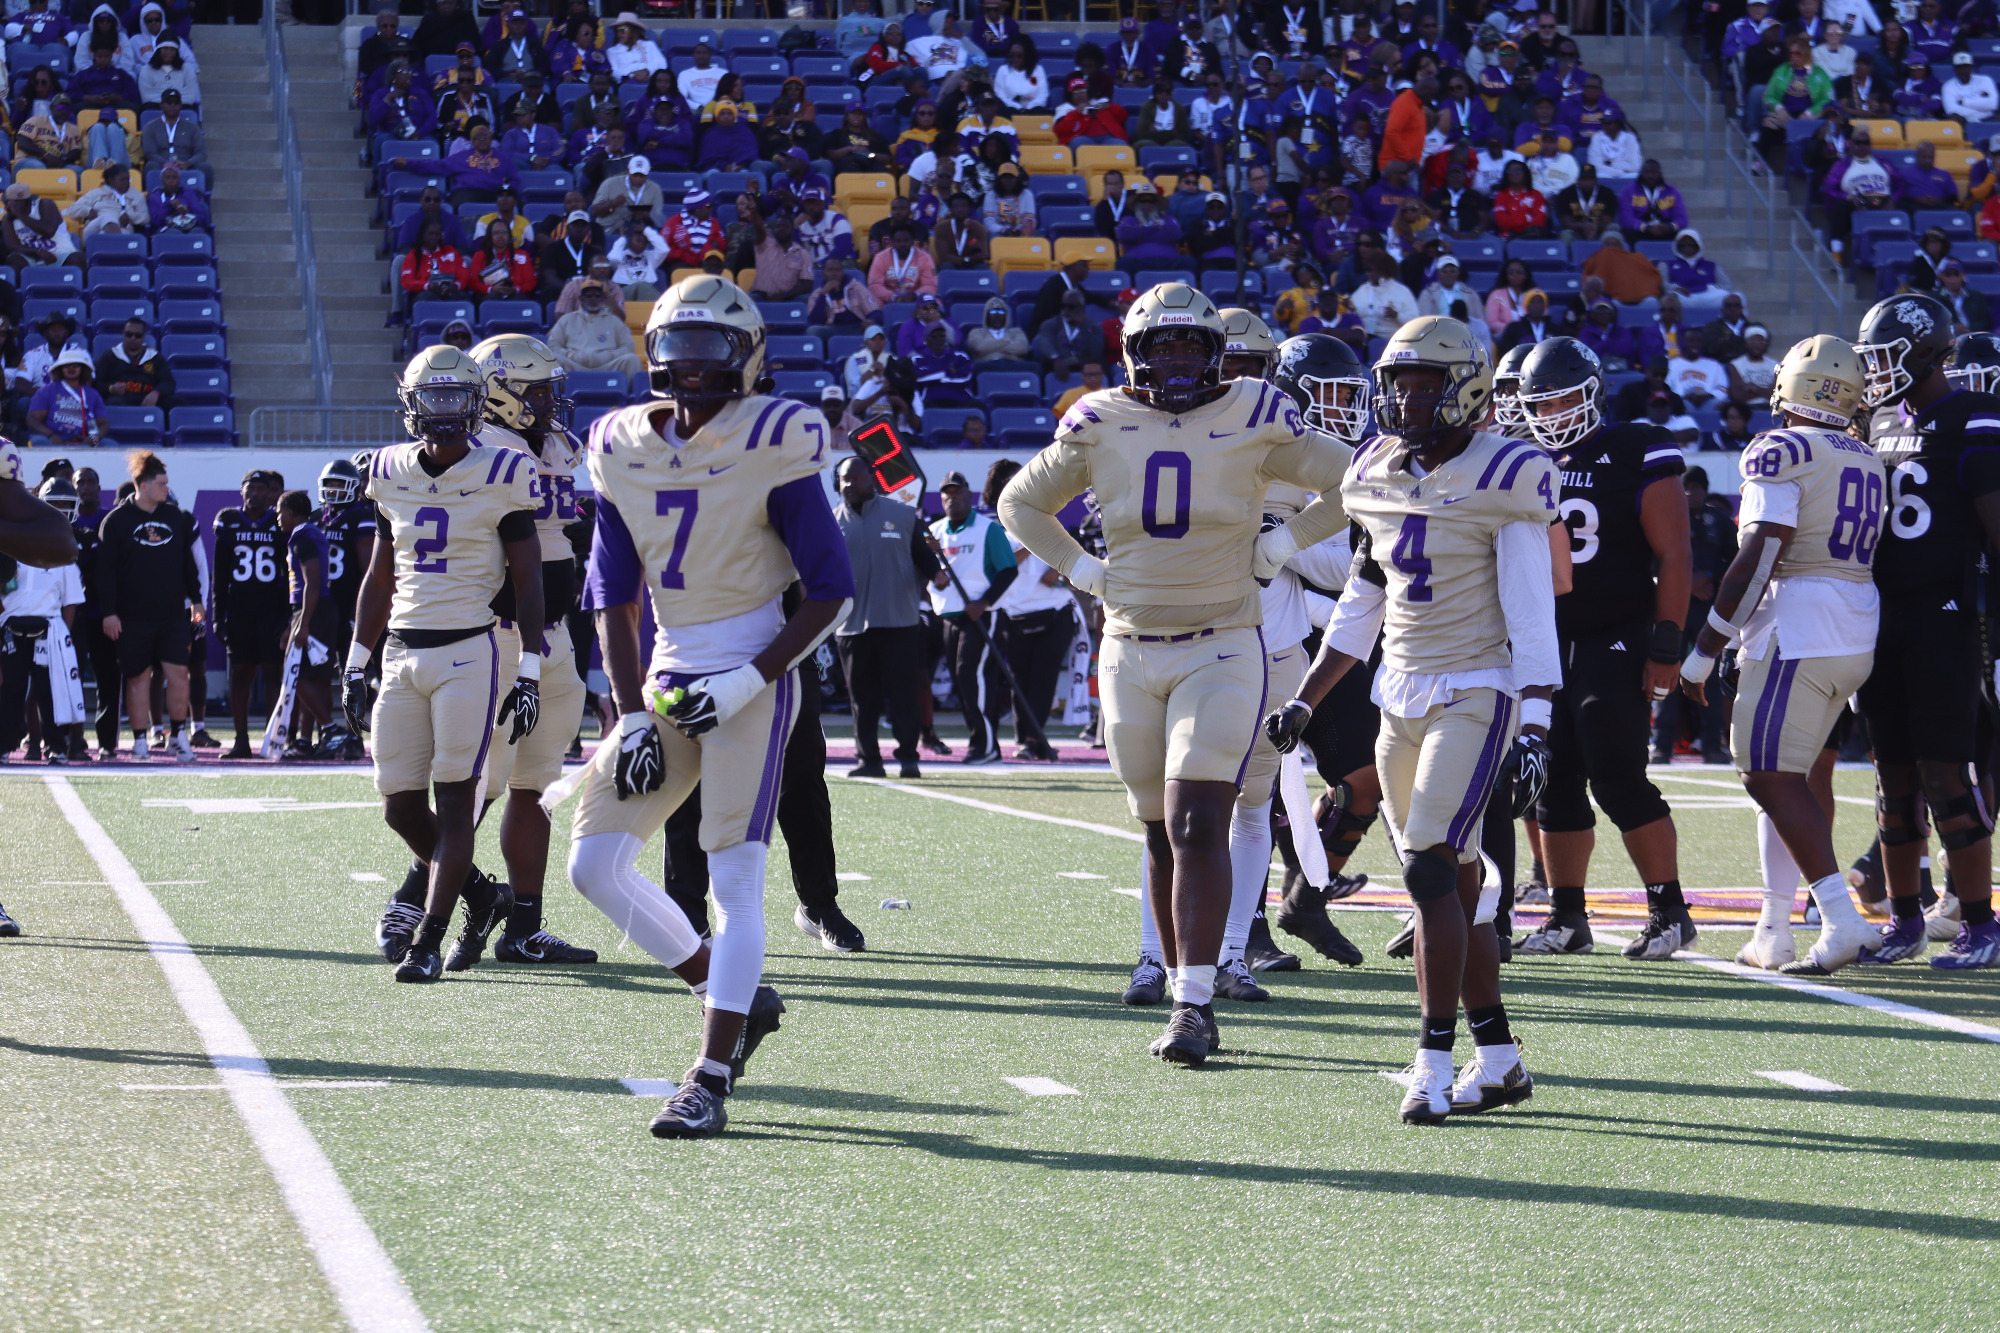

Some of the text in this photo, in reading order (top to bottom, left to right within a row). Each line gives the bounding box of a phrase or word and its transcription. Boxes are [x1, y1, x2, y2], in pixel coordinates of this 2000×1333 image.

[677, 310, 704, 318] GAS
[1161, 316, 1193, 324] Riddell
[477, 358, 517, 369] LCORN
[1389, 350, 1411, 358] GAS
[1821, 379, 1840, 395] 88
[1791, 405, 1846, 426] ALCORN STATE
[804, 423, 823, 461] 7
[1876, 436, 1923, 452] THE HILL
[857, 421, 917, 493] 2
[1745, 447, 1781, 477] 88
[1536, 471, 1555, 510] 4
[1559, 470, 1593, 488] HILL
[1142, 450, 1191, 539] 0
[1827, 466, 1881, 564] 88
[236, 532, 273, 542] THE HILL
[326, 531, 344, 541] HILL
[414, 506, 449, 573] 2
[656, 489, 698, 589] 7
[233, 545, 277, 582] 36
[1391, 514, 1433, 602] 4
